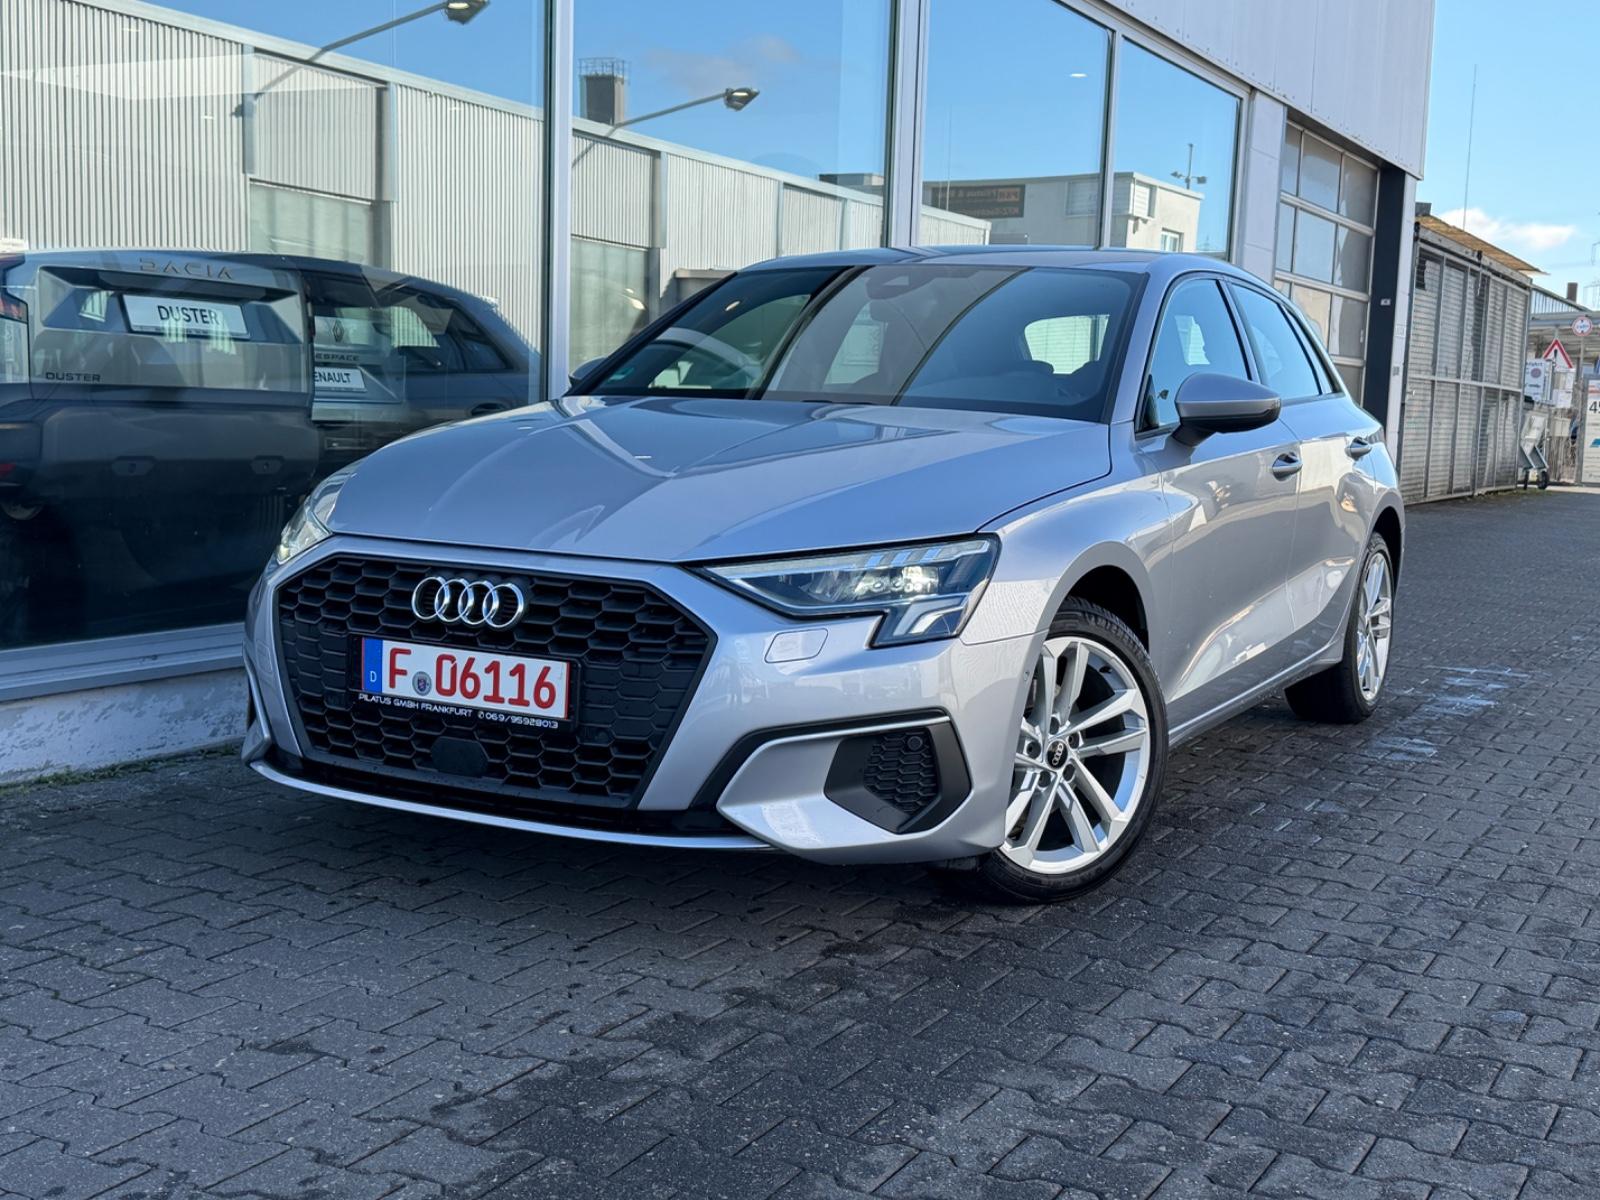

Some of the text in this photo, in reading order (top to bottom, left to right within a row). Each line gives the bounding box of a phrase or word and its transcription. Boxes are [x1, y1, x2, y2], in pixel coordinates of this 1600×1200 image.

[139, 258, 232, 280] DACIA
[157, 305, 220, 325] DUSTER
[315, 352, 360, 362] ESPACE
[45, 371, 101, 383] DUSTER
[314, 371, 352, 384] ENAULT
[369, 670, 377, 683] D
[388, 647, 557, 710] F 06116
[358, 693, 392, 706] PILATUS
[420, 702, 473, 718] FRANKFURT
